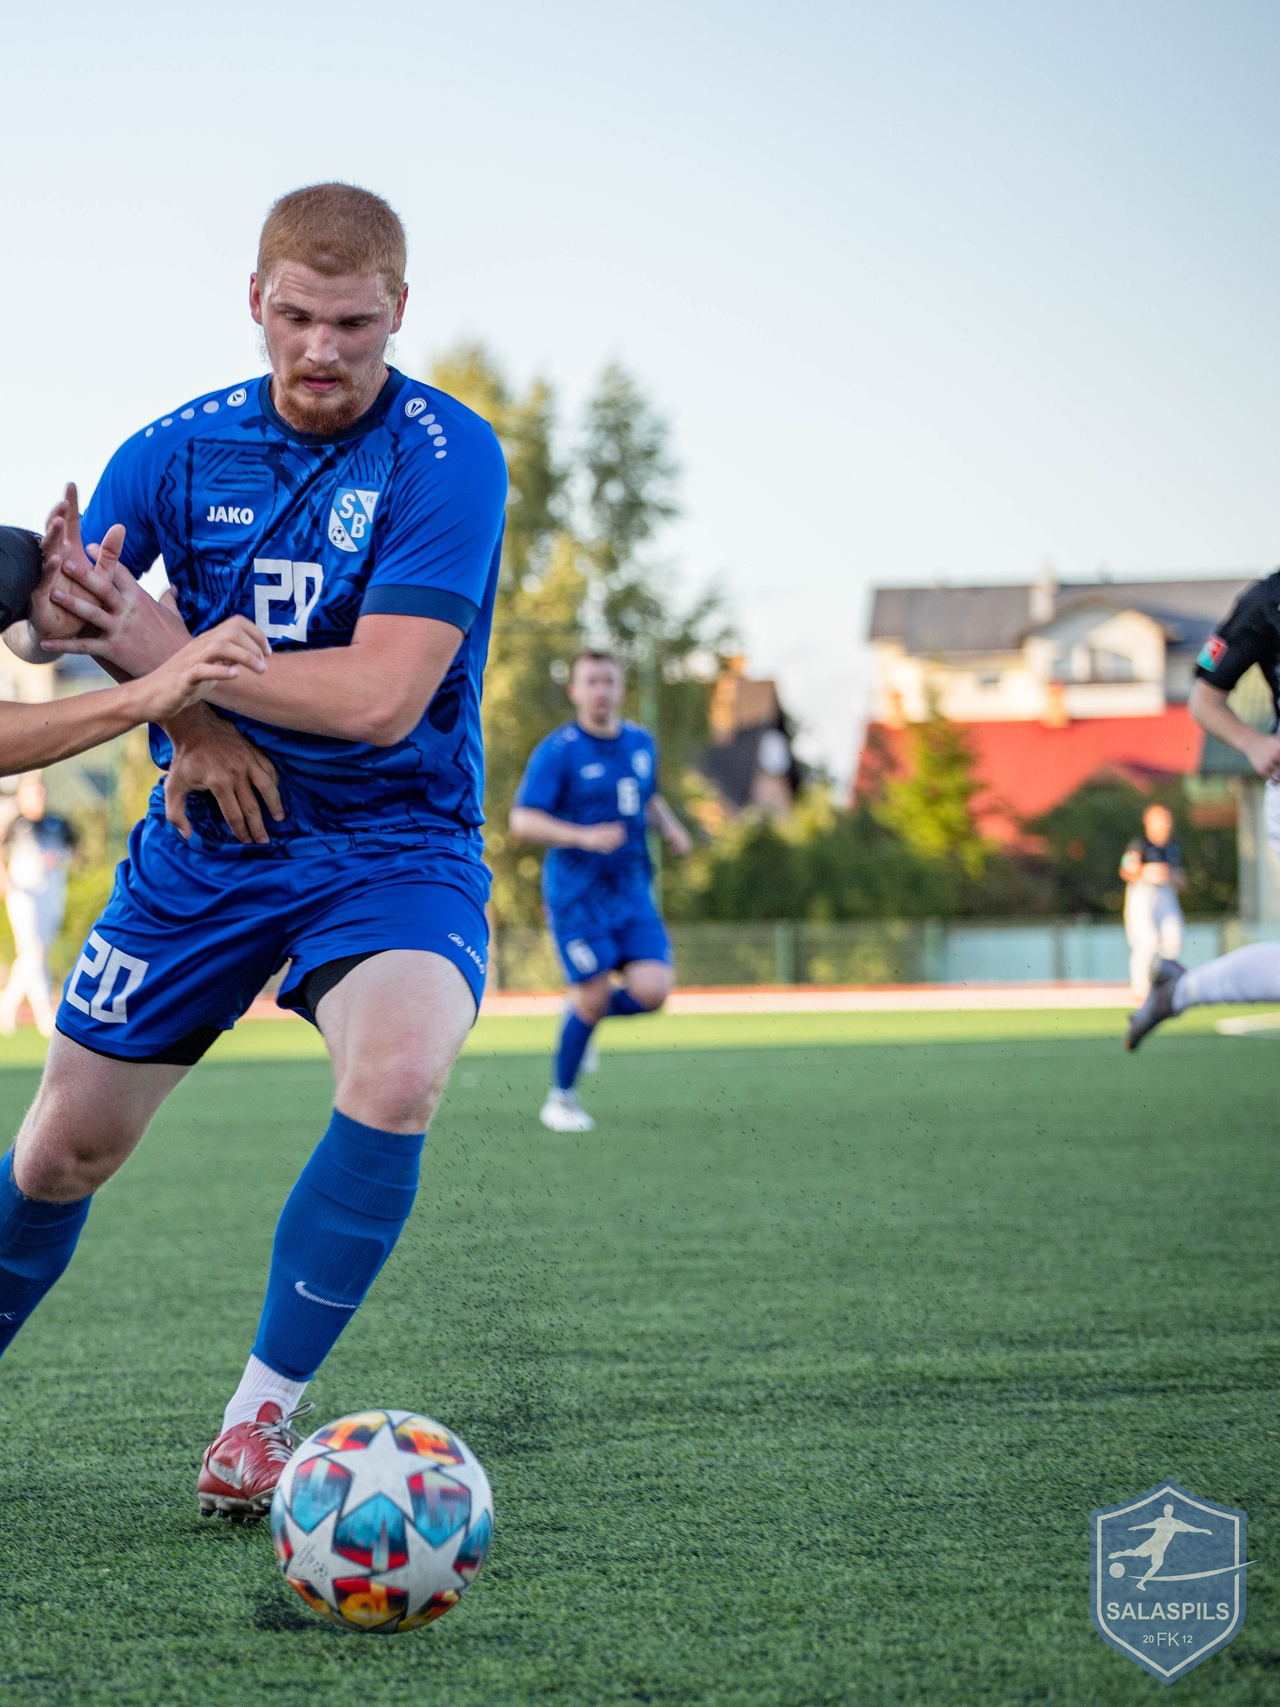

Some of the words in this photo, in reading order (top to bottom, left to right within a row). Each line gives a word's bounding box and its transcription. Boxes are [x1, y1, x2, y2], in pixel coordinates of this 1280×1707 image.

[206, 505, 254, 525] JAKO
[254, 557, 324, 643] 20
[65, 929, 150, 1024] 20
